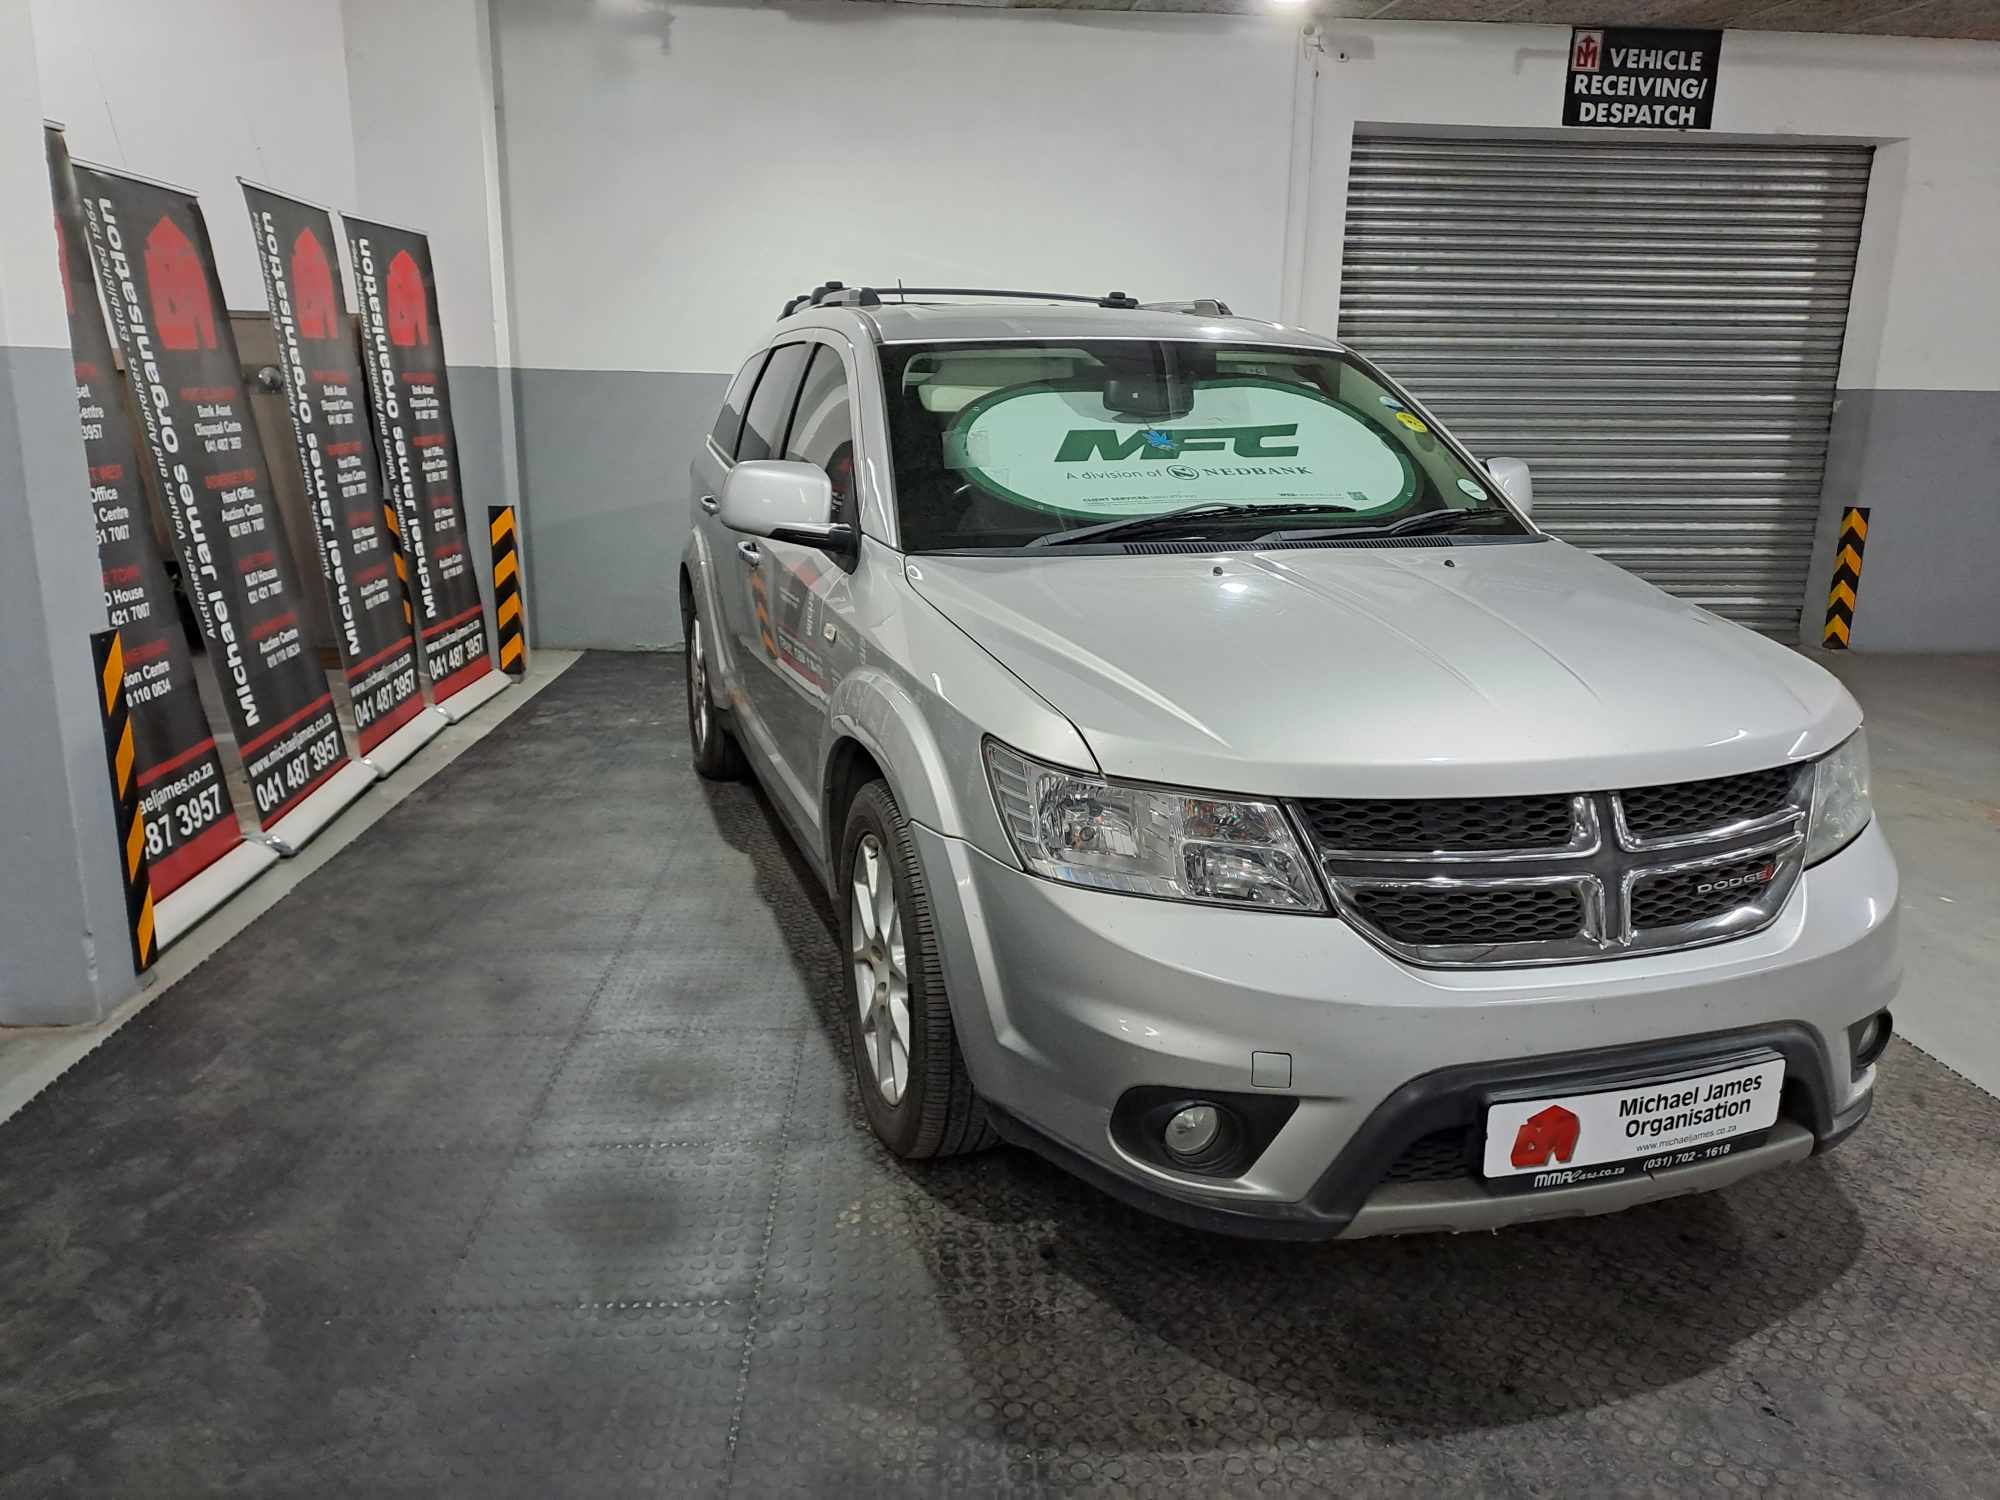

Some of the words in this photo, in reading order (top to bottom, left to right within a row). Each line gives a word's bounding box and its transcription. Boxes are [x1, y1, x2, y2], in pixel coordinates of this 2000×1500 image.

[1610, 47, 1703, 72] VEHICLE
[1574, 75, 1708, 99] RECEIVING/
[1579, 102, 1696, 126] DESPATCH
[83, 198, 102, 240] 1964
[95, 244, 130, 342] Established
[262, 211, 312, 424] Organisation
[99, 198, 178, 453] Organisation
[359, 238, 399, 418] Organisation
[152, 446, 168, 478] and
[1054, 424, 1298, 462] MFC
[306, 433, 334, 532] James
[393, 426, 416, 511] James
[1082, 467, 1143, 480] division
[1146, 469, 1163, 478] of
[1202, 464, 1312, 477] NEDBANK
[164, 482, 186, 539] Valuers
[173, 463, 218, 581] James
[96, 529, 107, 544] 51
[408, 518, 436, 618] Michael
[113, 585, 144, 604] House
[326, 539, 360, 656] Michael
[208, 590, 260, 727] Michael
[429, 653, 448, 680] 041
[449, 644, 464, 669] 487
[465, 633, 483, 660] 3957
[354, 696, 375, 727] 041
[376, 684, 394, 712] 487
[393, 668, 416, 701] 3957
[139, 762, 214, 816] aeljames.co.za
[256, 771, 286, 811] 041
[286, 752, 309, 788] 487
[310, 731, 339, 771] 3957
[145, 814, 172, 860] 87
[175, 783, 221, 836] 3957
[1697, 870, 1767, 894] DODGE
[1619, 1087, 1699, 1117] Michael
[1703, 1073, 1762, 1103] James
[1625, 1098, 1751, 1138] Organisation
[1636, 1123, 1737, 1153] www.michaeljames.co.za
[1643, 1156, 1672, 1171] (031)
[1675, 1152, 1696, 1166] 702
[1706, 1144, 1731, 1160] 1618
